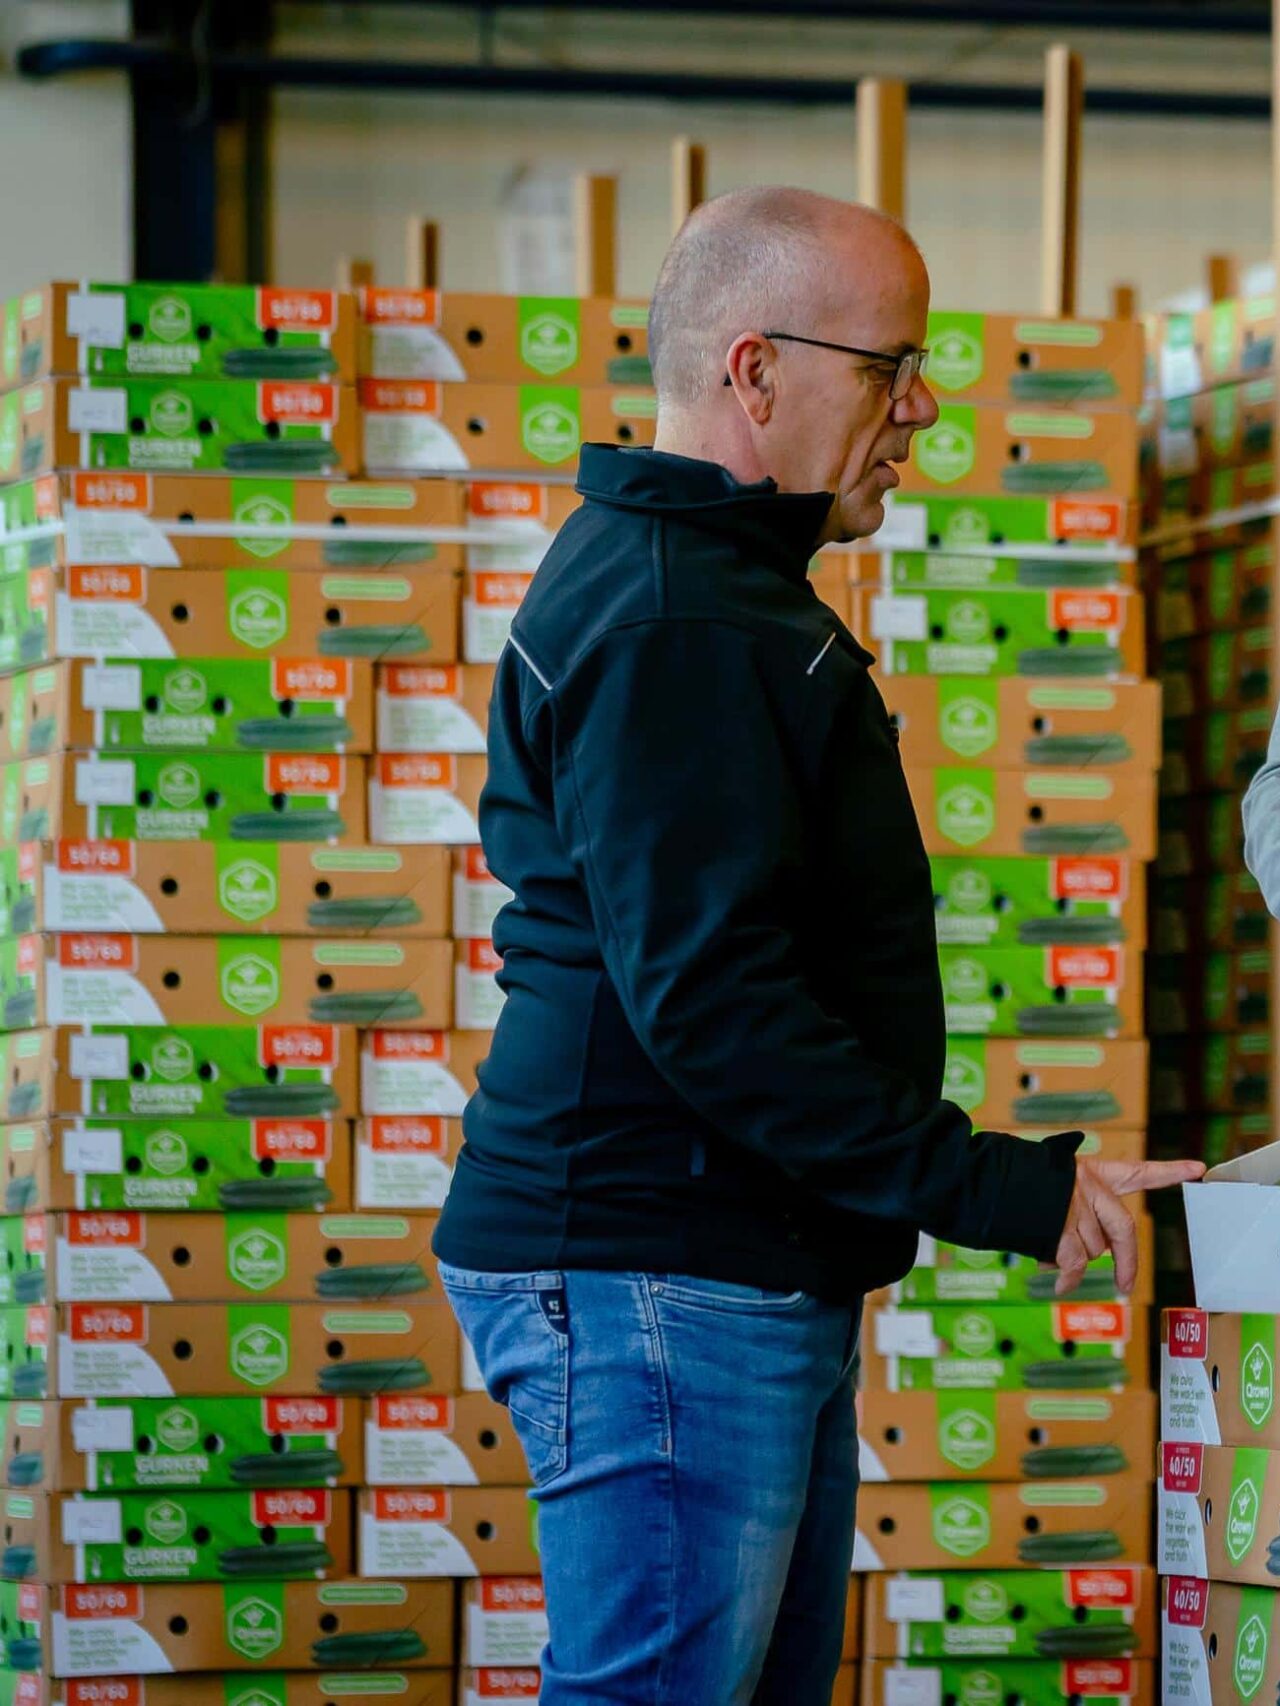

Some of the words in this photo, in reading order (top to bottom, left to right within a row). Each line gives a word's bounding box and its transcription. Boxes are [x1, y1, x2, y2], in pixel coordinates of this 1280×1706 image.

[1175, 1323, 1201, 1343] 40/50
[1169, 1457, 1196, 1478] 40/50
[1174, 1592, 1200, 1612] 40/50
